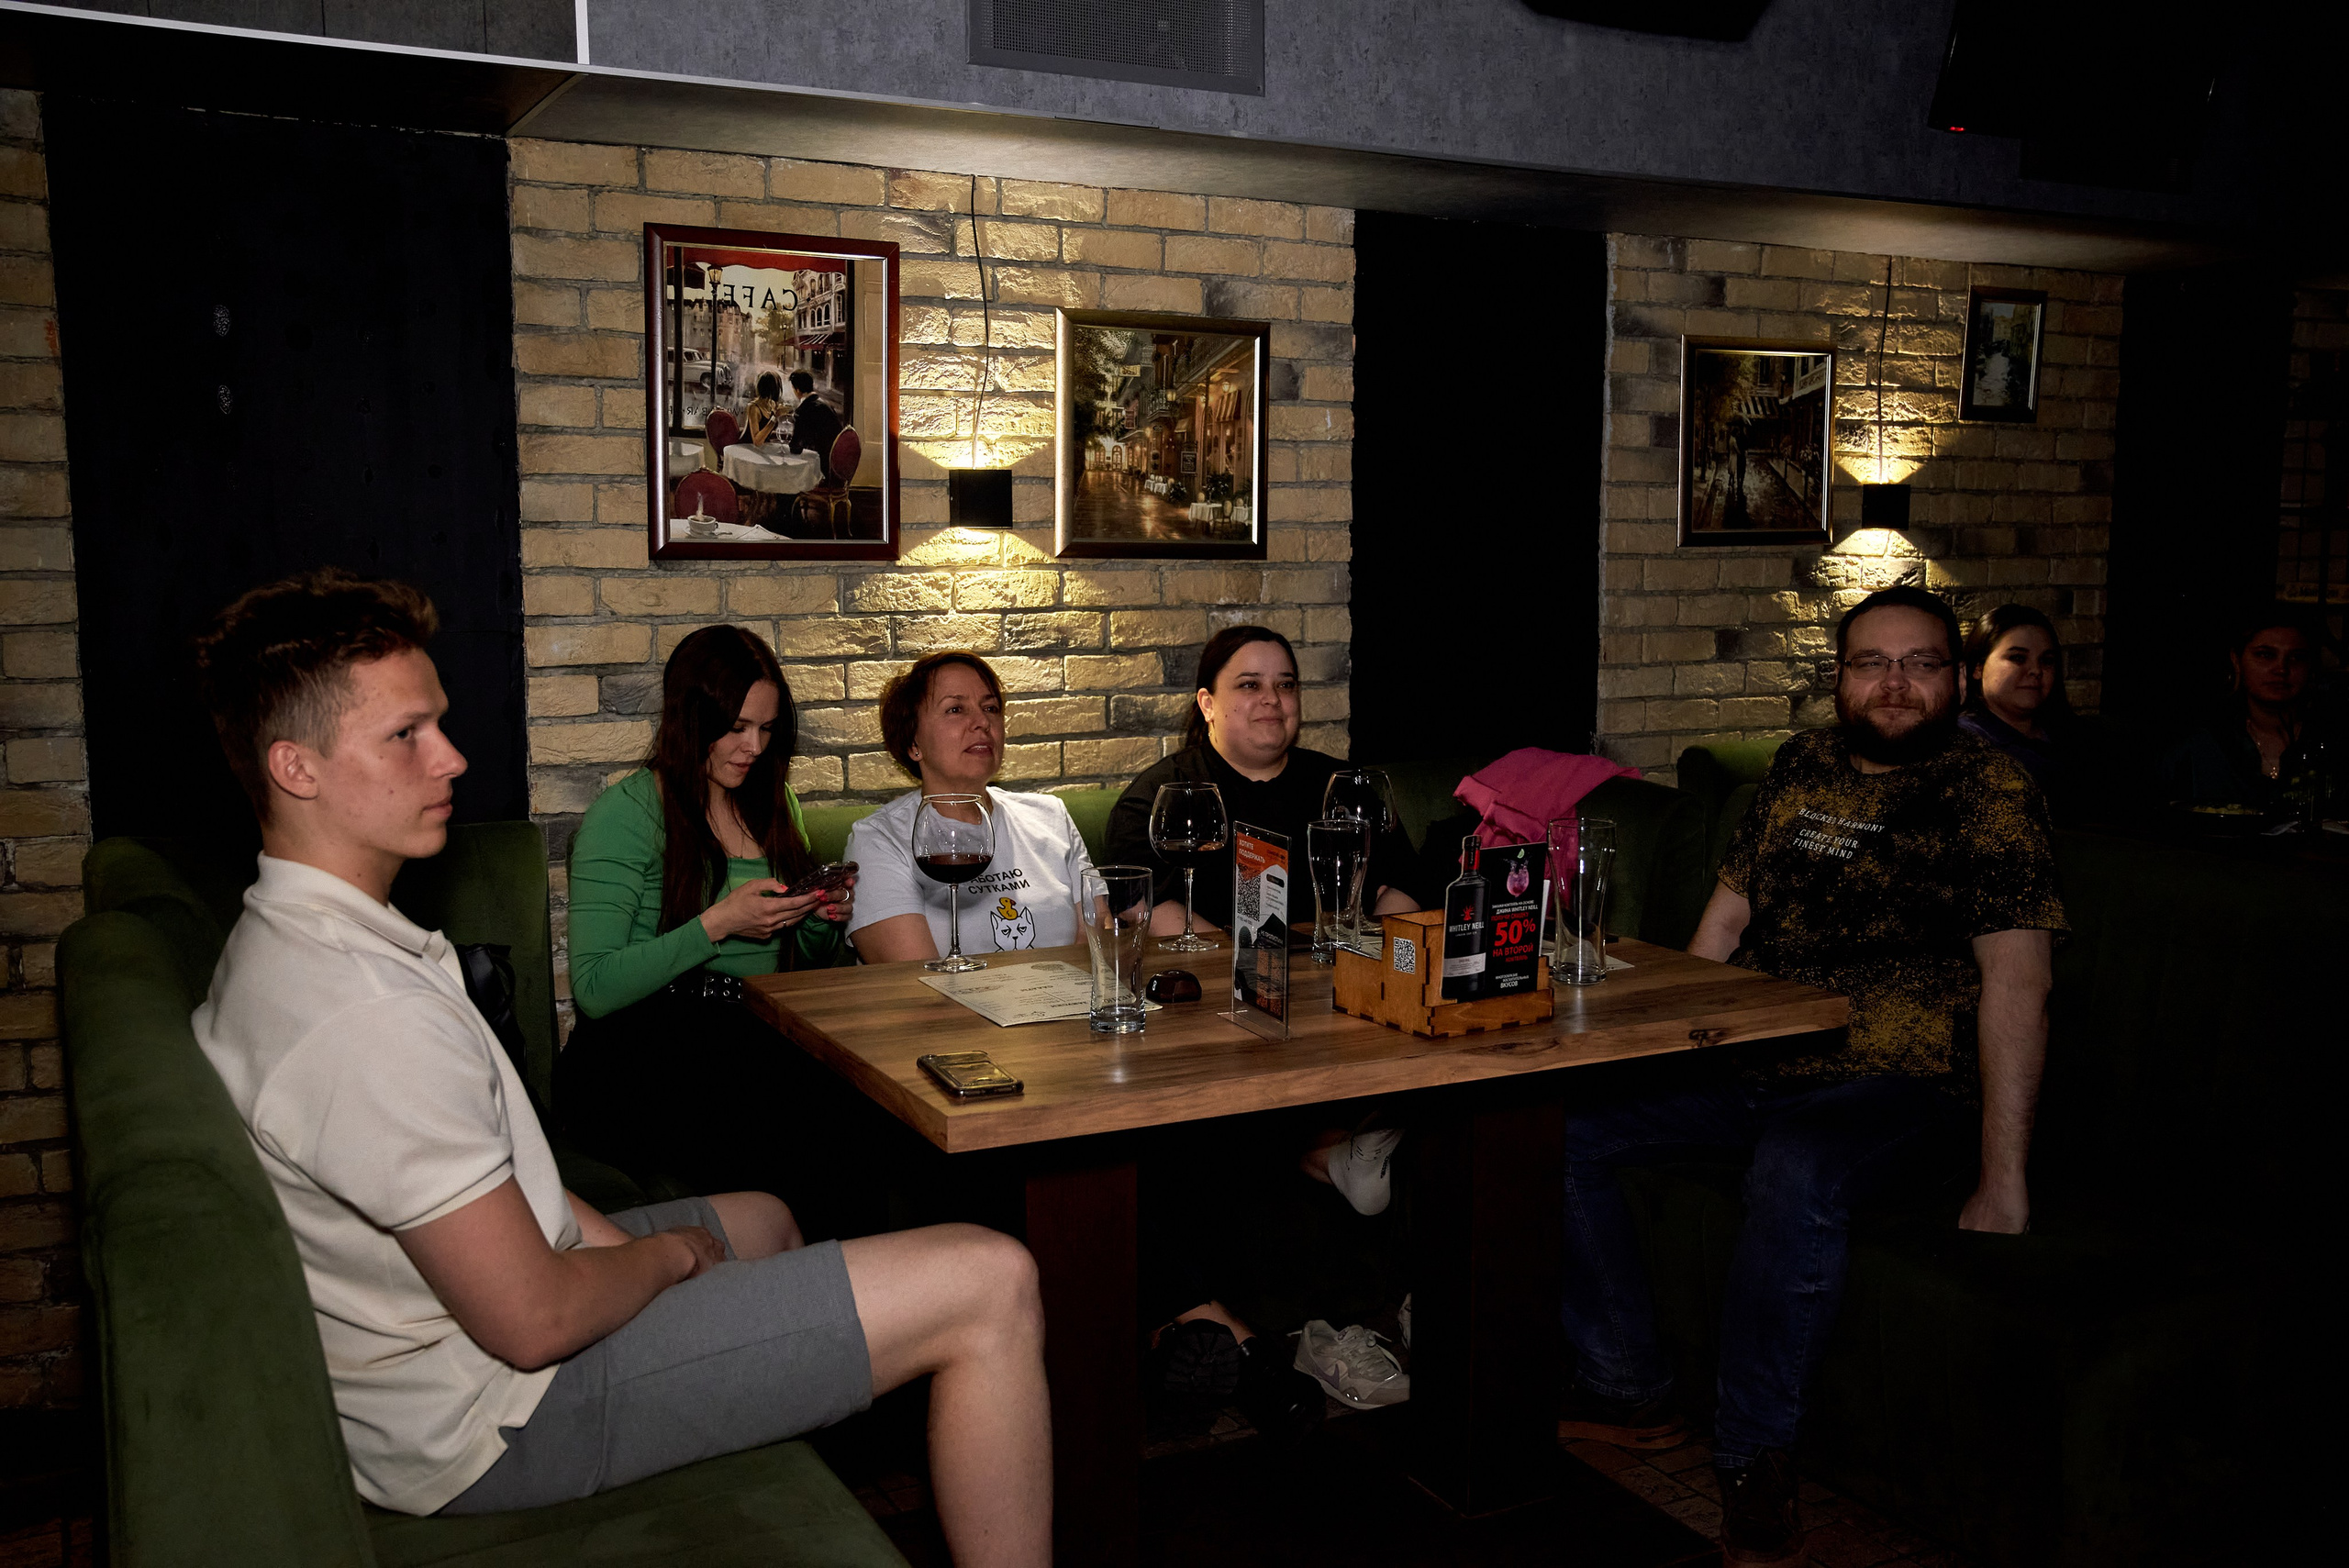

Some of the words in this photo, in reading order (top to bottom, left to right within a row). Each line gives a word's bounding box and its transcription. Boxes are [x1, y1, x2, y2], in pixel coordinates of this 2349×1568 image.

[1838, 817, 1886, 833] HARMONY
[1799, 828, 1833, 843] CREATE
[1834, 836, 1859, 849] YOUR
[1793, 838, 1826, 852] FINEST
[1827, 847, 1854, 859] MIND
[970, 868, 1023, 884] АБОТАЮ
[968, 879, 1030, 895] СУТКАМИ
[1494, 918, 1536, 947] 50%
[1492, 948, 1503, 958] НА
[1504, 942, 1533, 956] ВТОРОЙ
